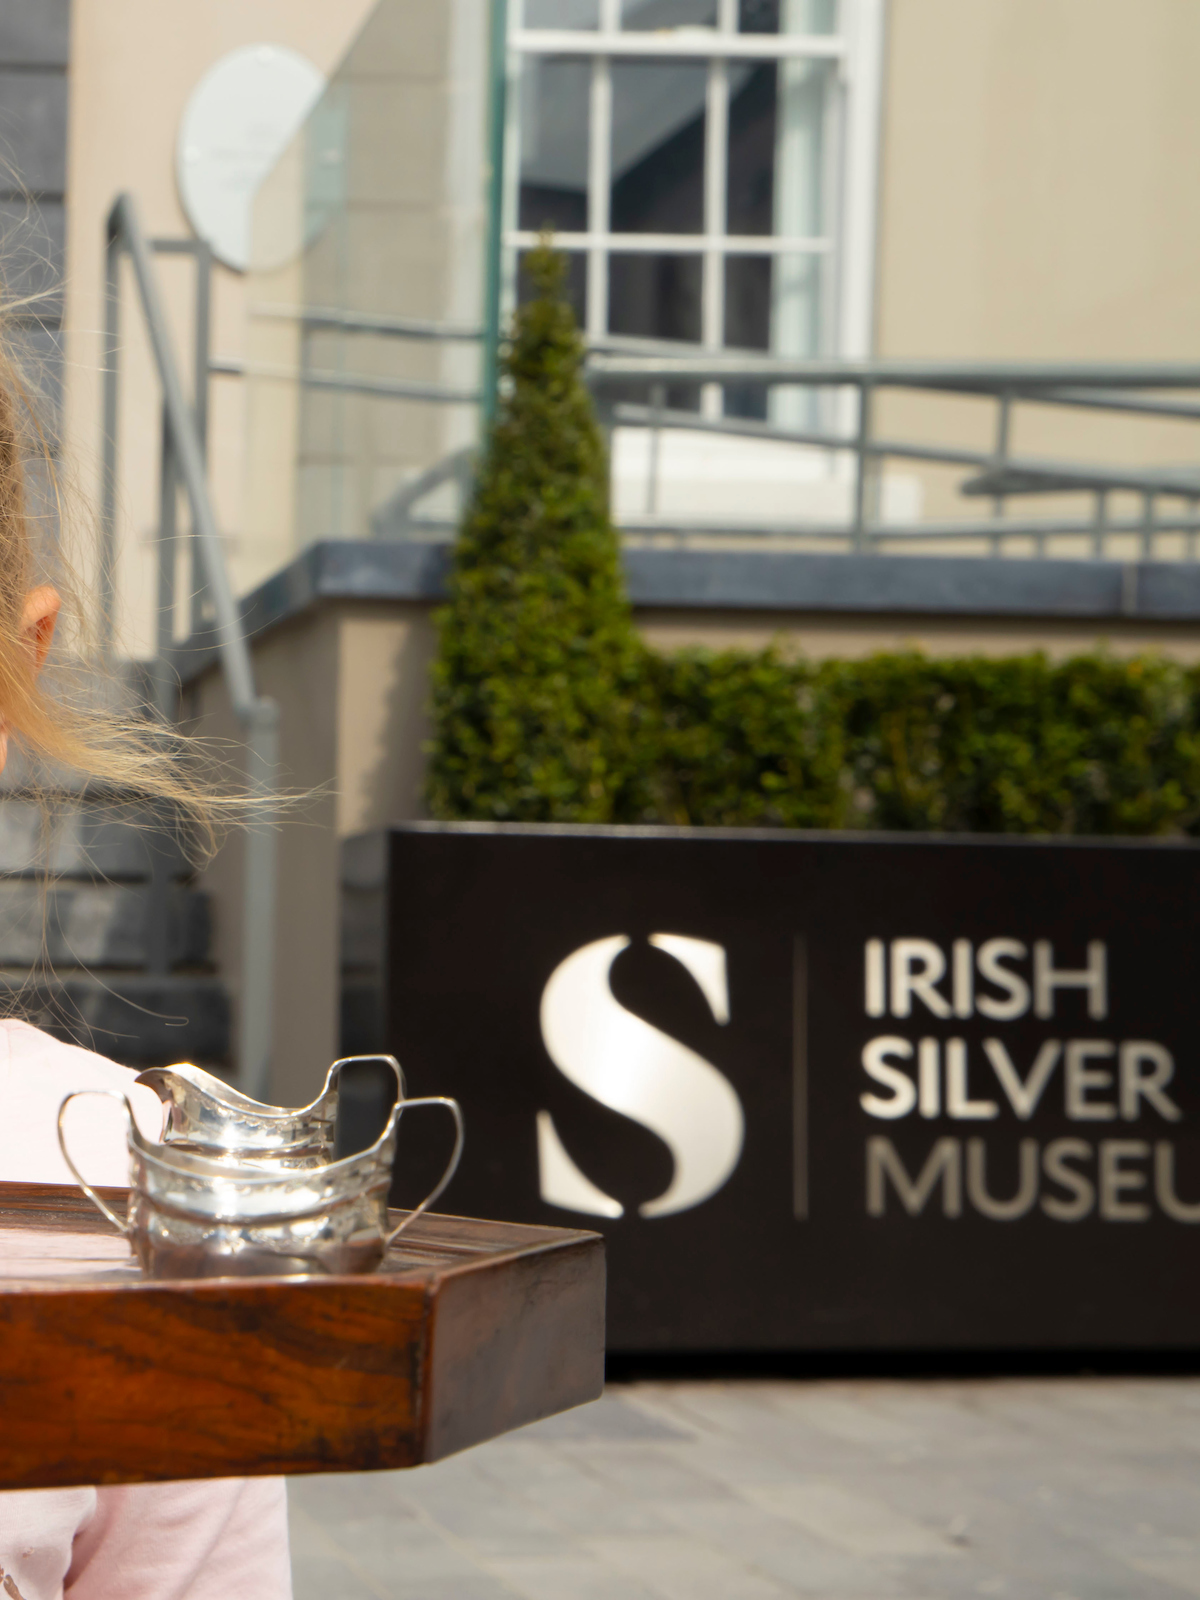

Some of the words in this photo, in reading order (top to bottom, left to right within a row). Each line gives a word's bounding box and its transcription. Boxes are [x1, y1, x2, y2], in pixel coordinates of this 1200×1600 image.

[864, 938, 1107, 1020] IRISH
[537, 933, 744, 1219] S
[859, 1035, 1180, 1121] SILVER
[865, 1135, 1200, 1223] MUSEU
